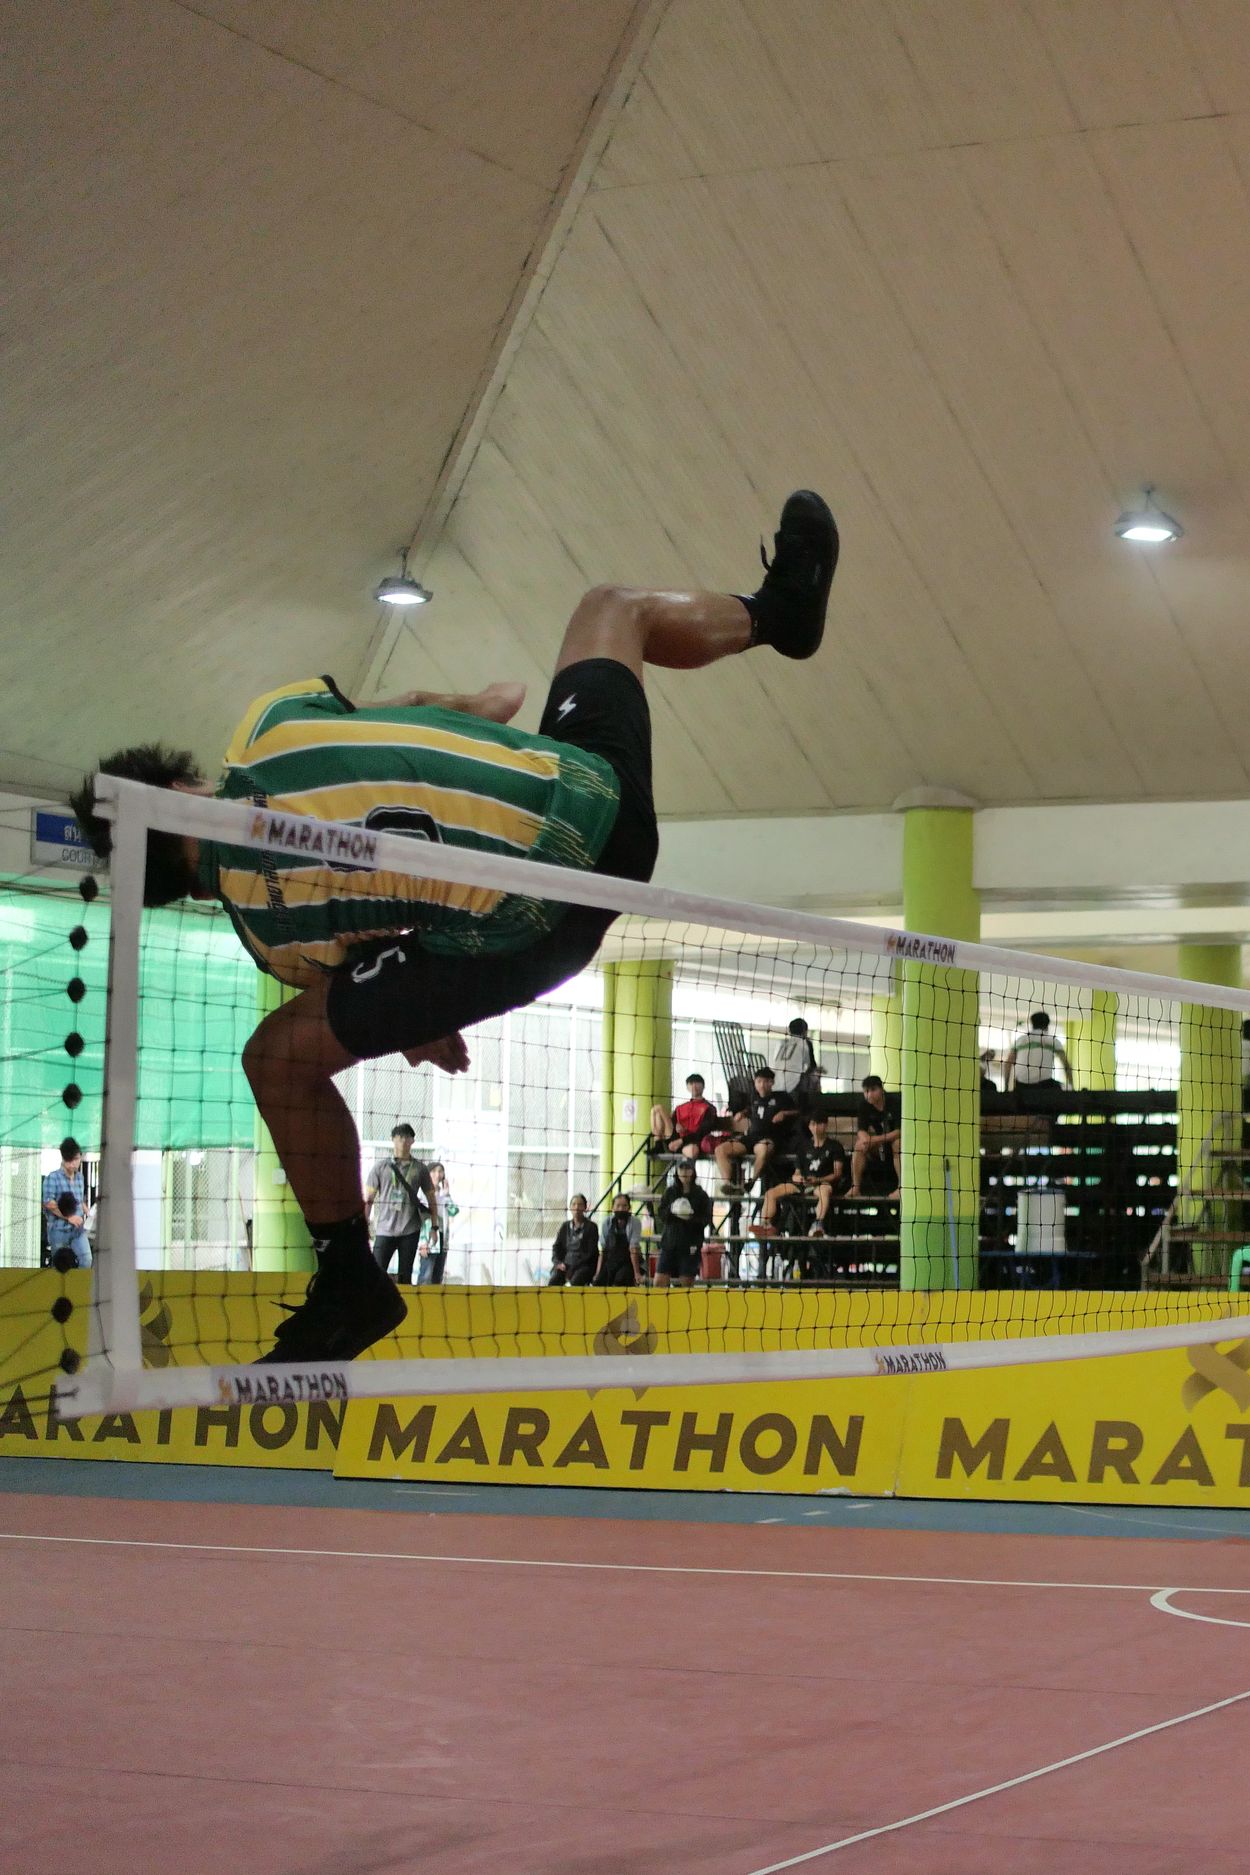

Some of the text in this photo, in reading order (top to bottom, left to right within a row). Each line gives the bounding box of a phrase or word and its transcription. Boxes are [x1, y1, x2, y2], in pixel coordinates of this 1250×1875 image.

[268, 819, 378, 862] MARATHON
[896, 936, 956, 964] MARATHON
[884, 1352, 947, 1375] MARATHON
[234, 1373, 348, 1402] MARATHON
[367, 1403, 865, 1477] MARATHON
